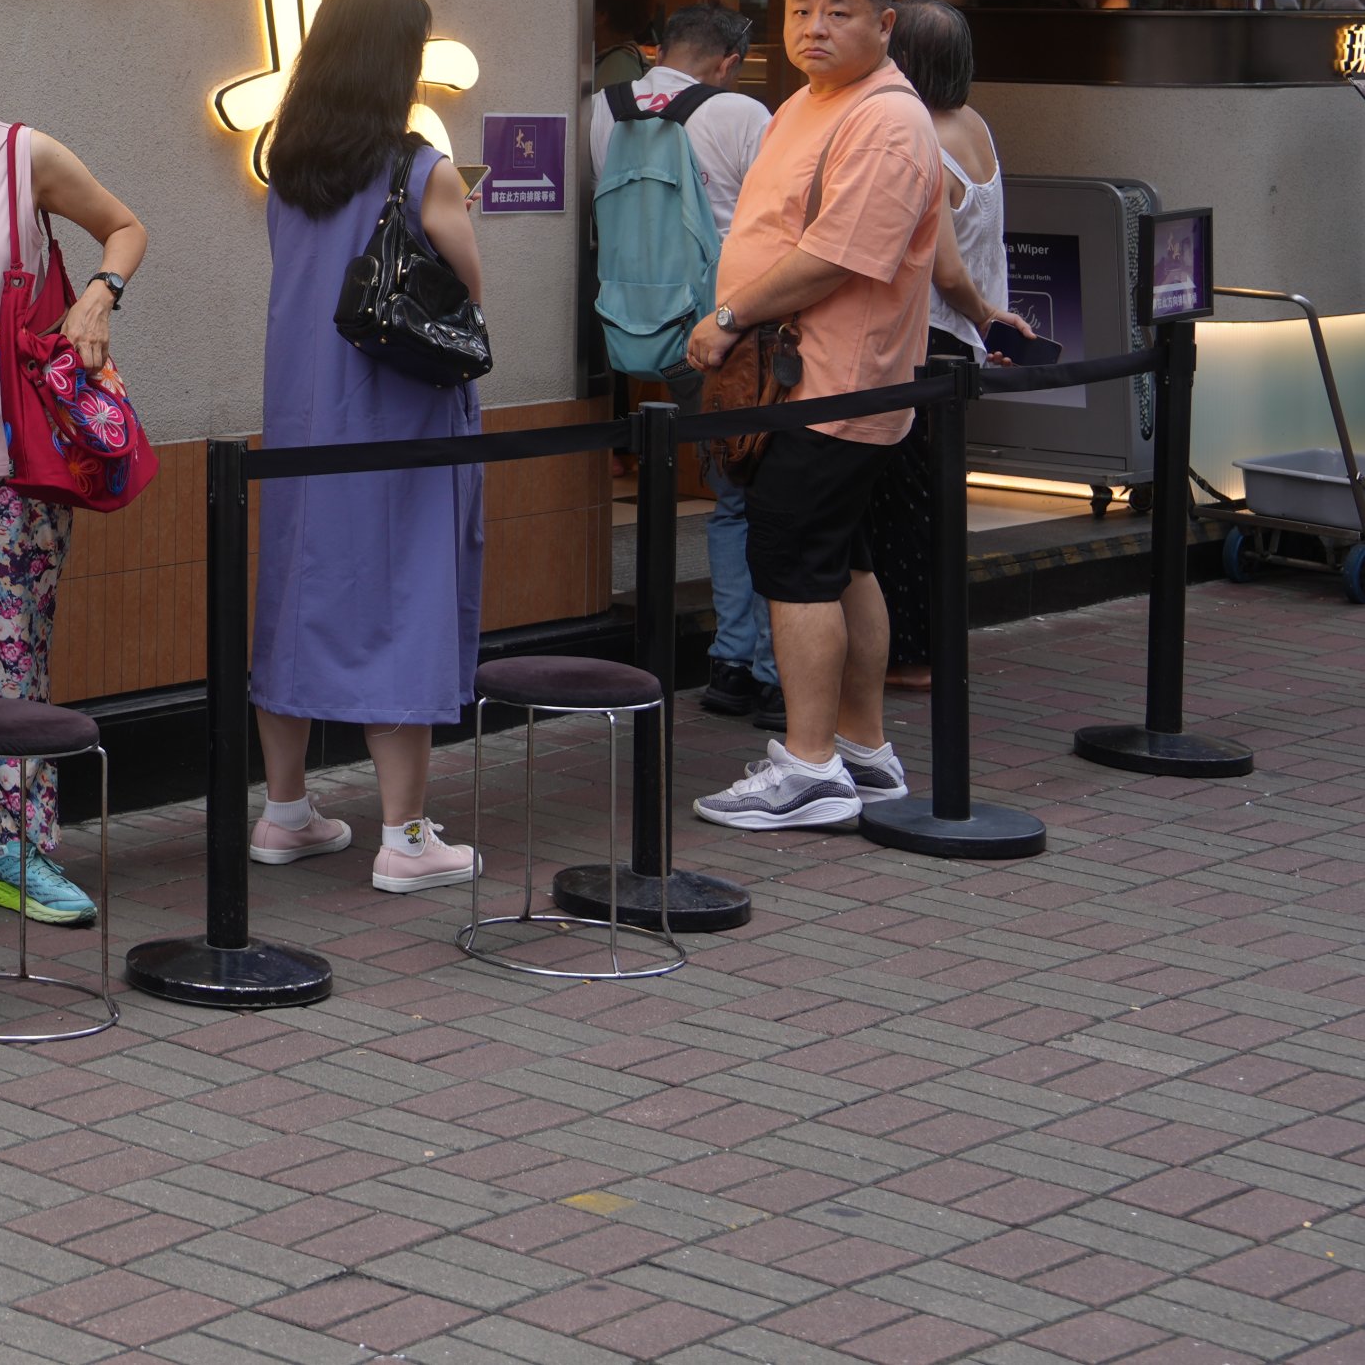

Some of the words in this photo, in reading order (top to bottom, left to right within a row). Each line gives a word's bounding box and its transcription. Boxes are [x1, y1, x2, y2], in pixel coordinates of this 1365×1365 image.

[491, 190, 557, 203] 請在此方向排隊等候
[1017, 243, 1050, 256] Wiper
